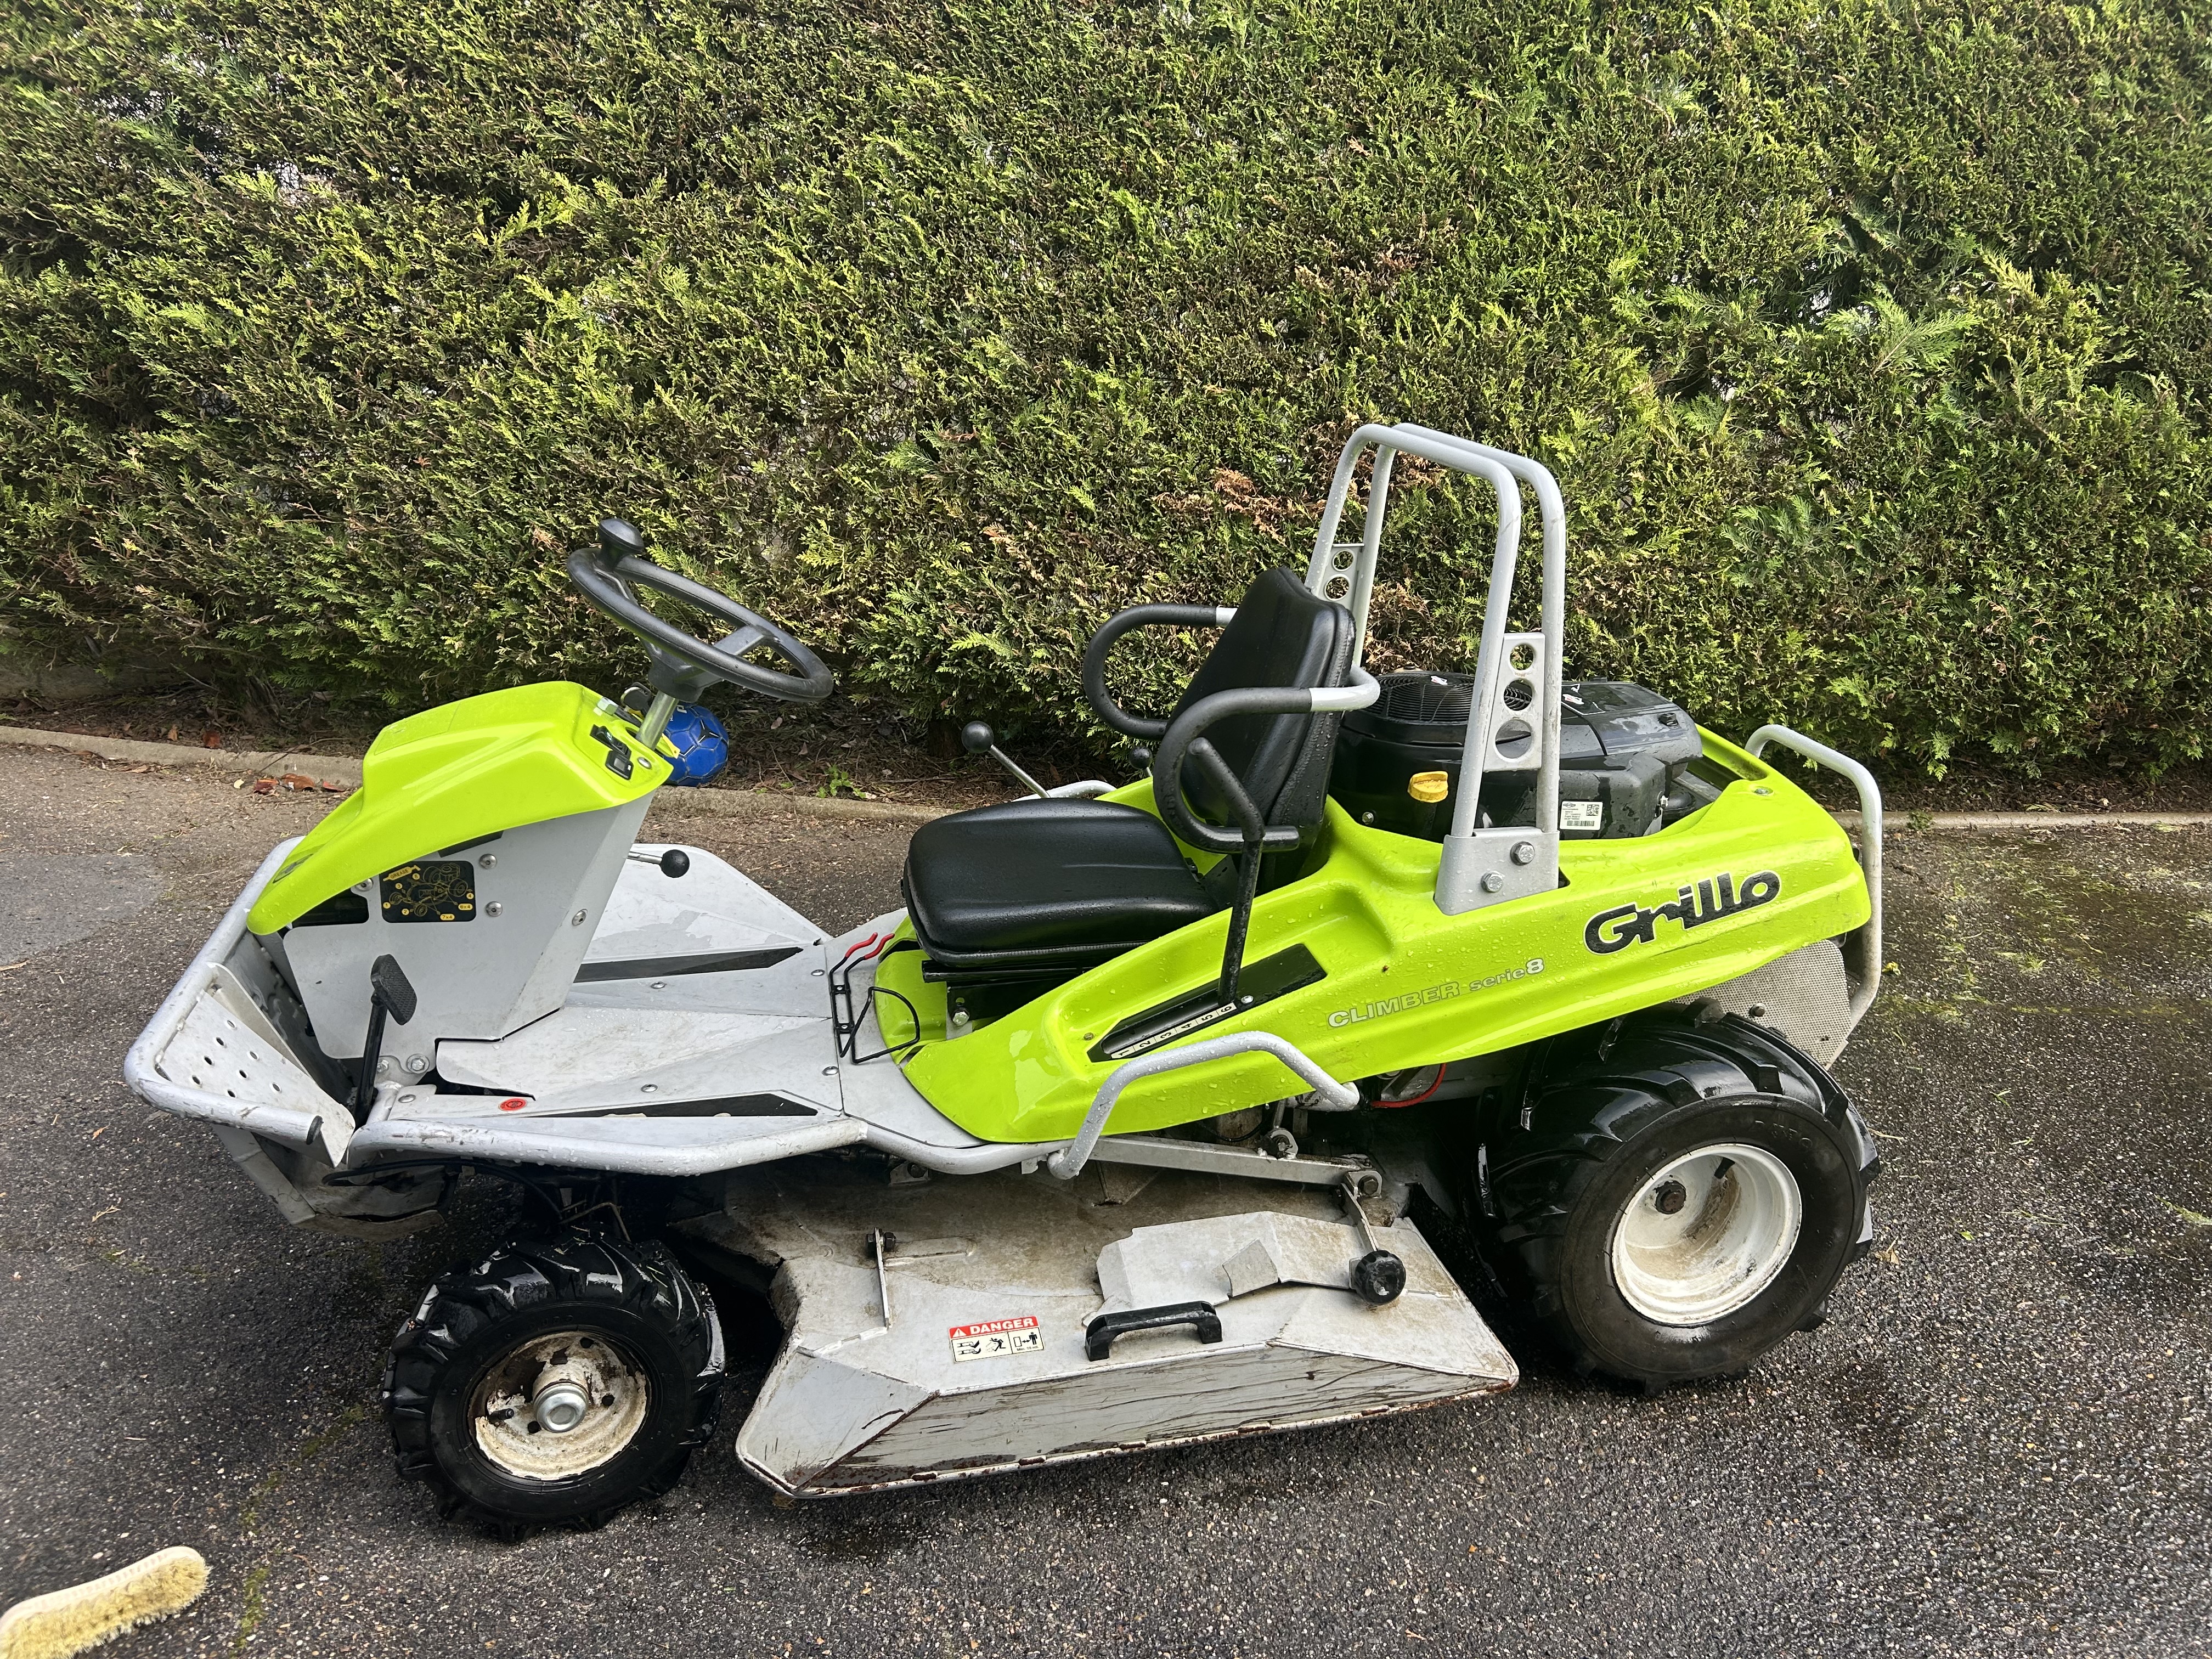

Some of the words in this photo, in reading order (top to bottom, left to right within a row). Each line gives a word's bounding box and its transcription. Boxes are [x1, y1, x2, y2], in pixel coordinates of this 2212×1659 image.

[390, 868, 409, 879] GREASE
[1583, 870, 1781, 955] Grillo
[1328, 981, 1460, 1028] CLIMBER
[969, 1318, 1034, 1335] DANGER
